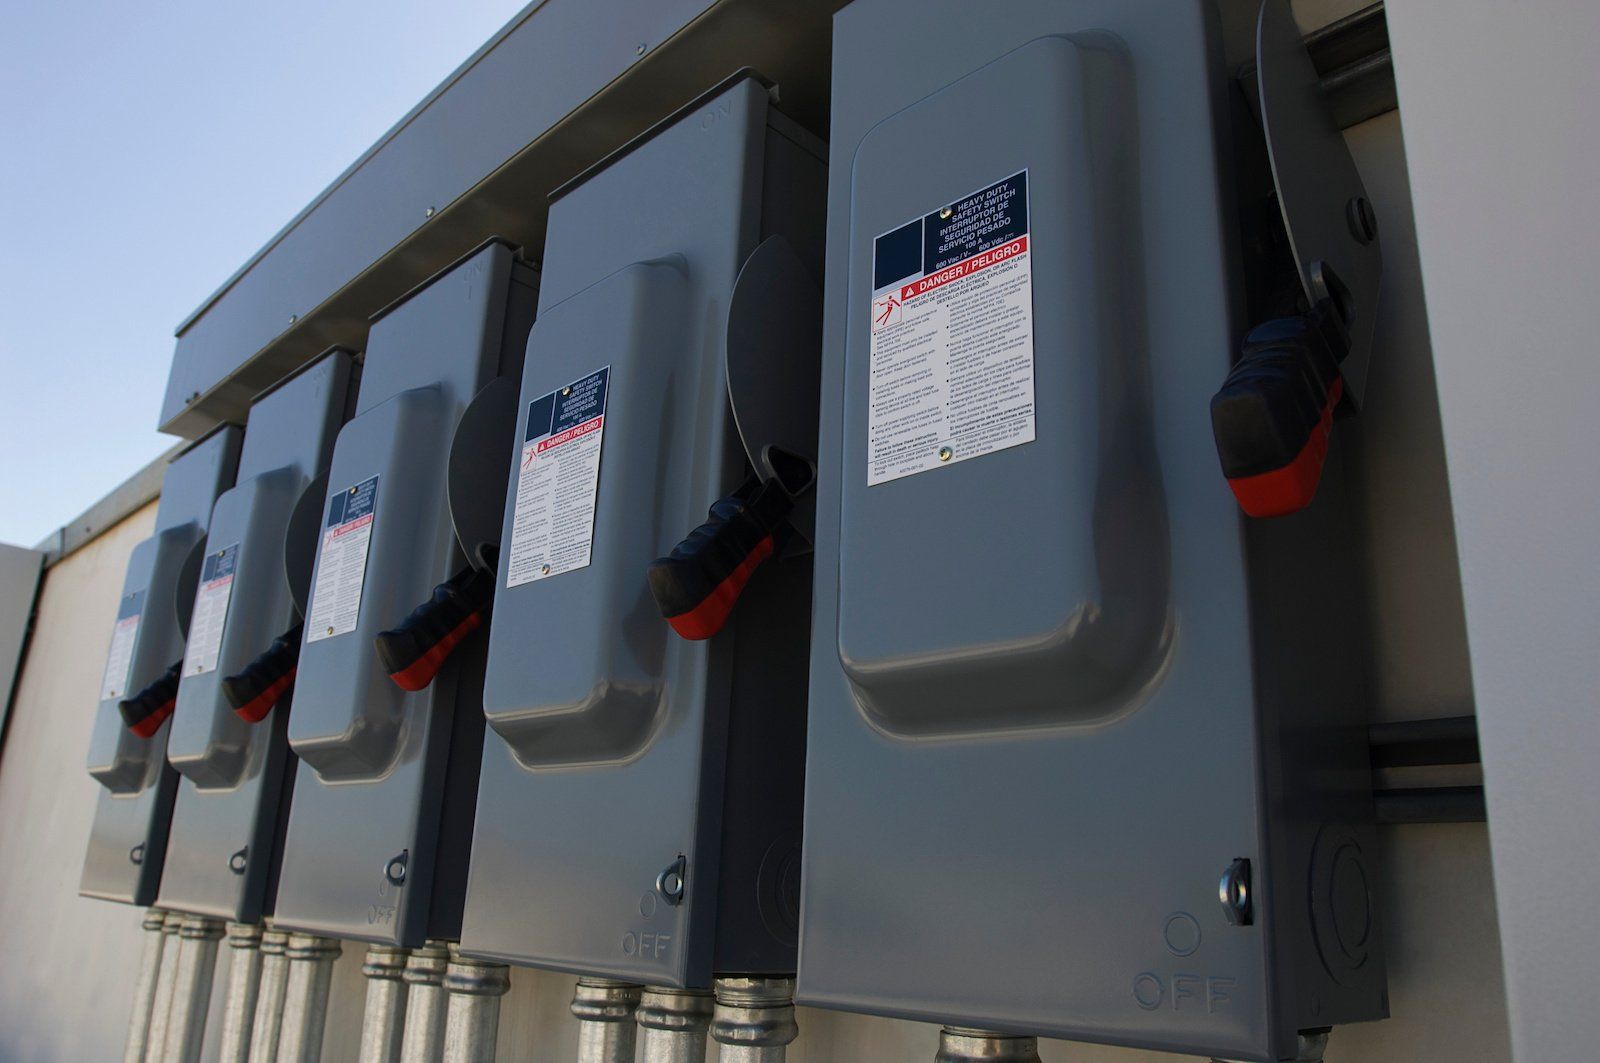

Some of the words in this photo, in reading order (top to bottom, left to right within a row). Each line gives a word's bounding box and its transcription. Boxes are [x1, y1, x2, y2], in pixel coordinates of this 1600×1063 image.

[952, 203, 982, 223] SAFETY
[984, 189, 1015, 209] SWITCH
[958, 194, 985, 212] HEAVY
[987, 183, 1008, 199] DUTY
[940, 206, 995, 237] INTERRUPTOR
[998, 200, 1009, 212] DE
[945, 217, 991, 243] SEGURIDAD
[993, 211, 1004, 222] DE
[939, 232, 975, 254] SERVICIO
[977, 217, 1011, 238] PESADO
[965, 240, 976, 250] 100
[978, 237, 982, 245] A
[979, 242, 990, 251] 600
[920, 266, 963, 291] DANGER
[972, 242, 1020, 271] PELIGRO
[928, 285, 947, 297] ELECTRIC
[937, 287, 959, 300] DESCARGA
[547, 432, 570, 447] DANGER
[574, 420, 599, 436] PELIGRO
[622, 931, 671, 959] OFF
[1131, 972, 1237, 1014] OFF
